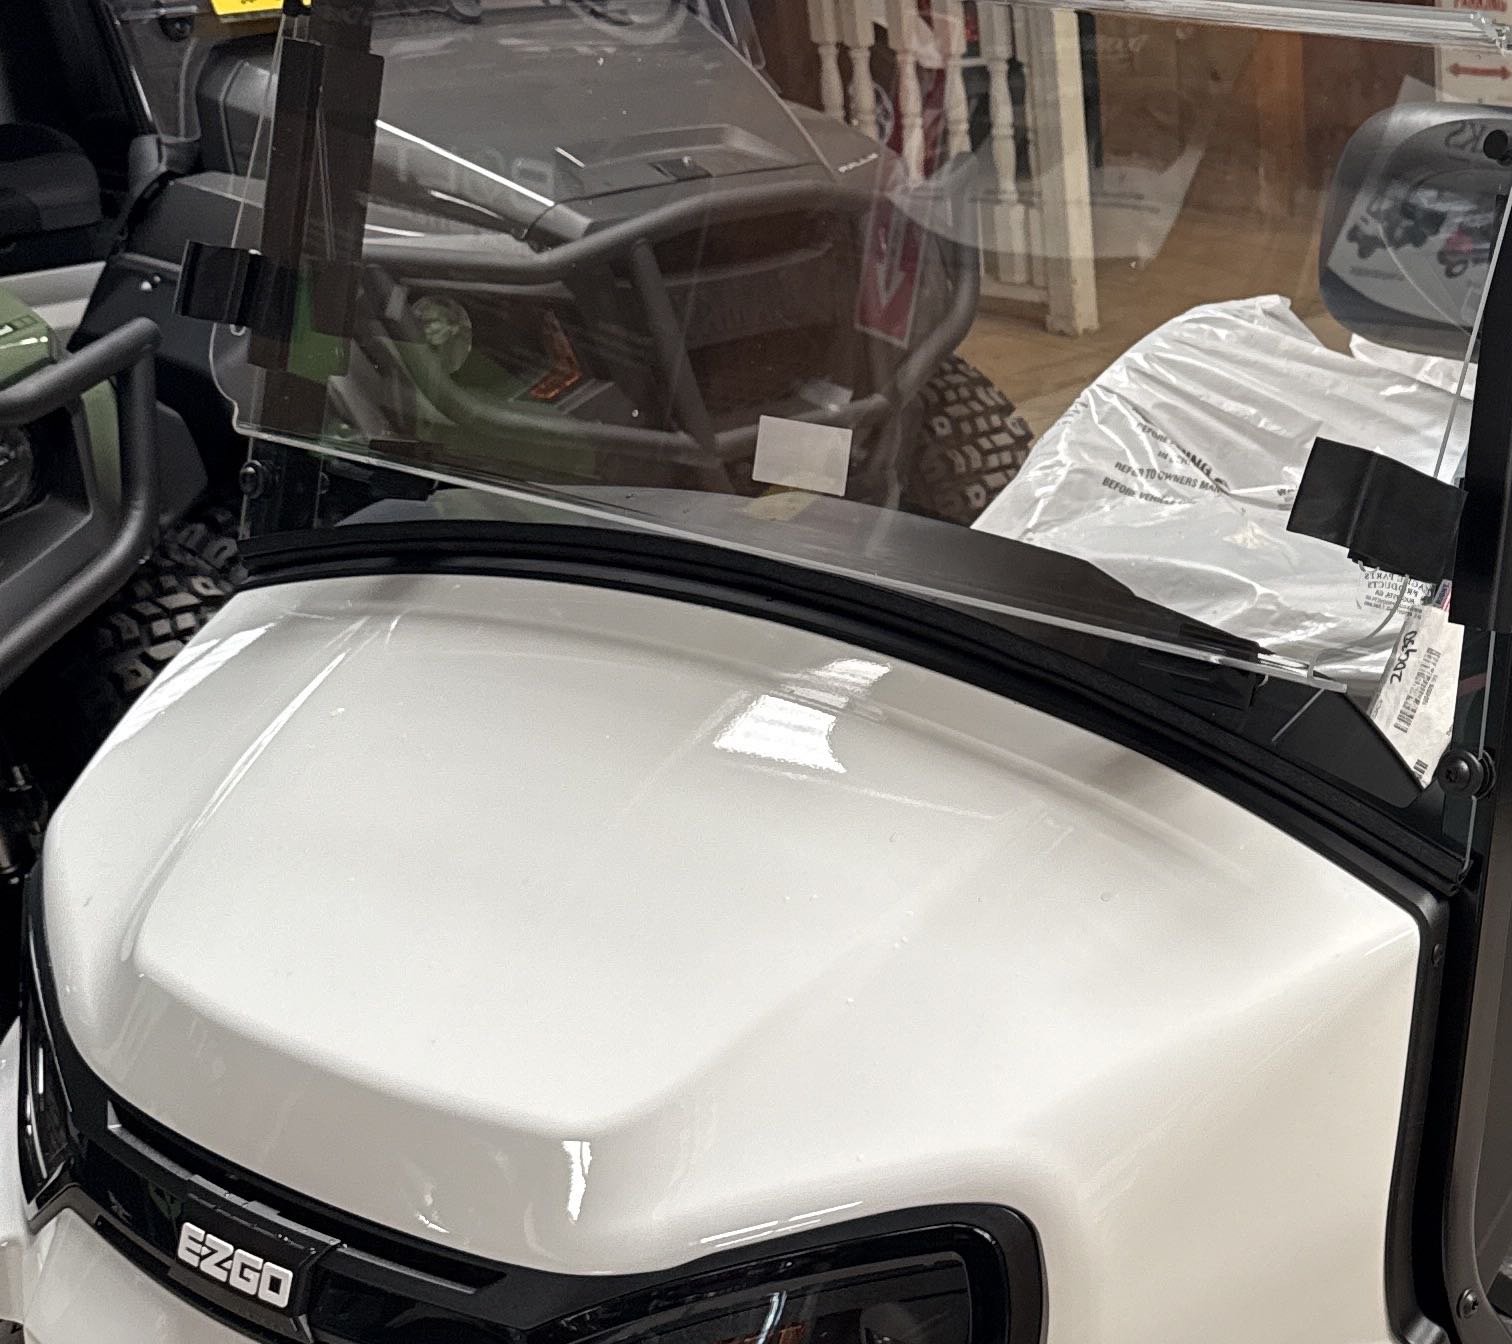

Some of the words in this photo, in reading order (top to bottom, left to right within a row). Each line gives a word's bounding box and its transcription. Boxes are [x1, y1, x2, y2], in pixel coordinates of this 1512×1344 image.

[1145, 467, 1157, 480] TO
[1158, 471, 1198, 488] OWNERS
[178, 1221, 294, 1309] EZGO
